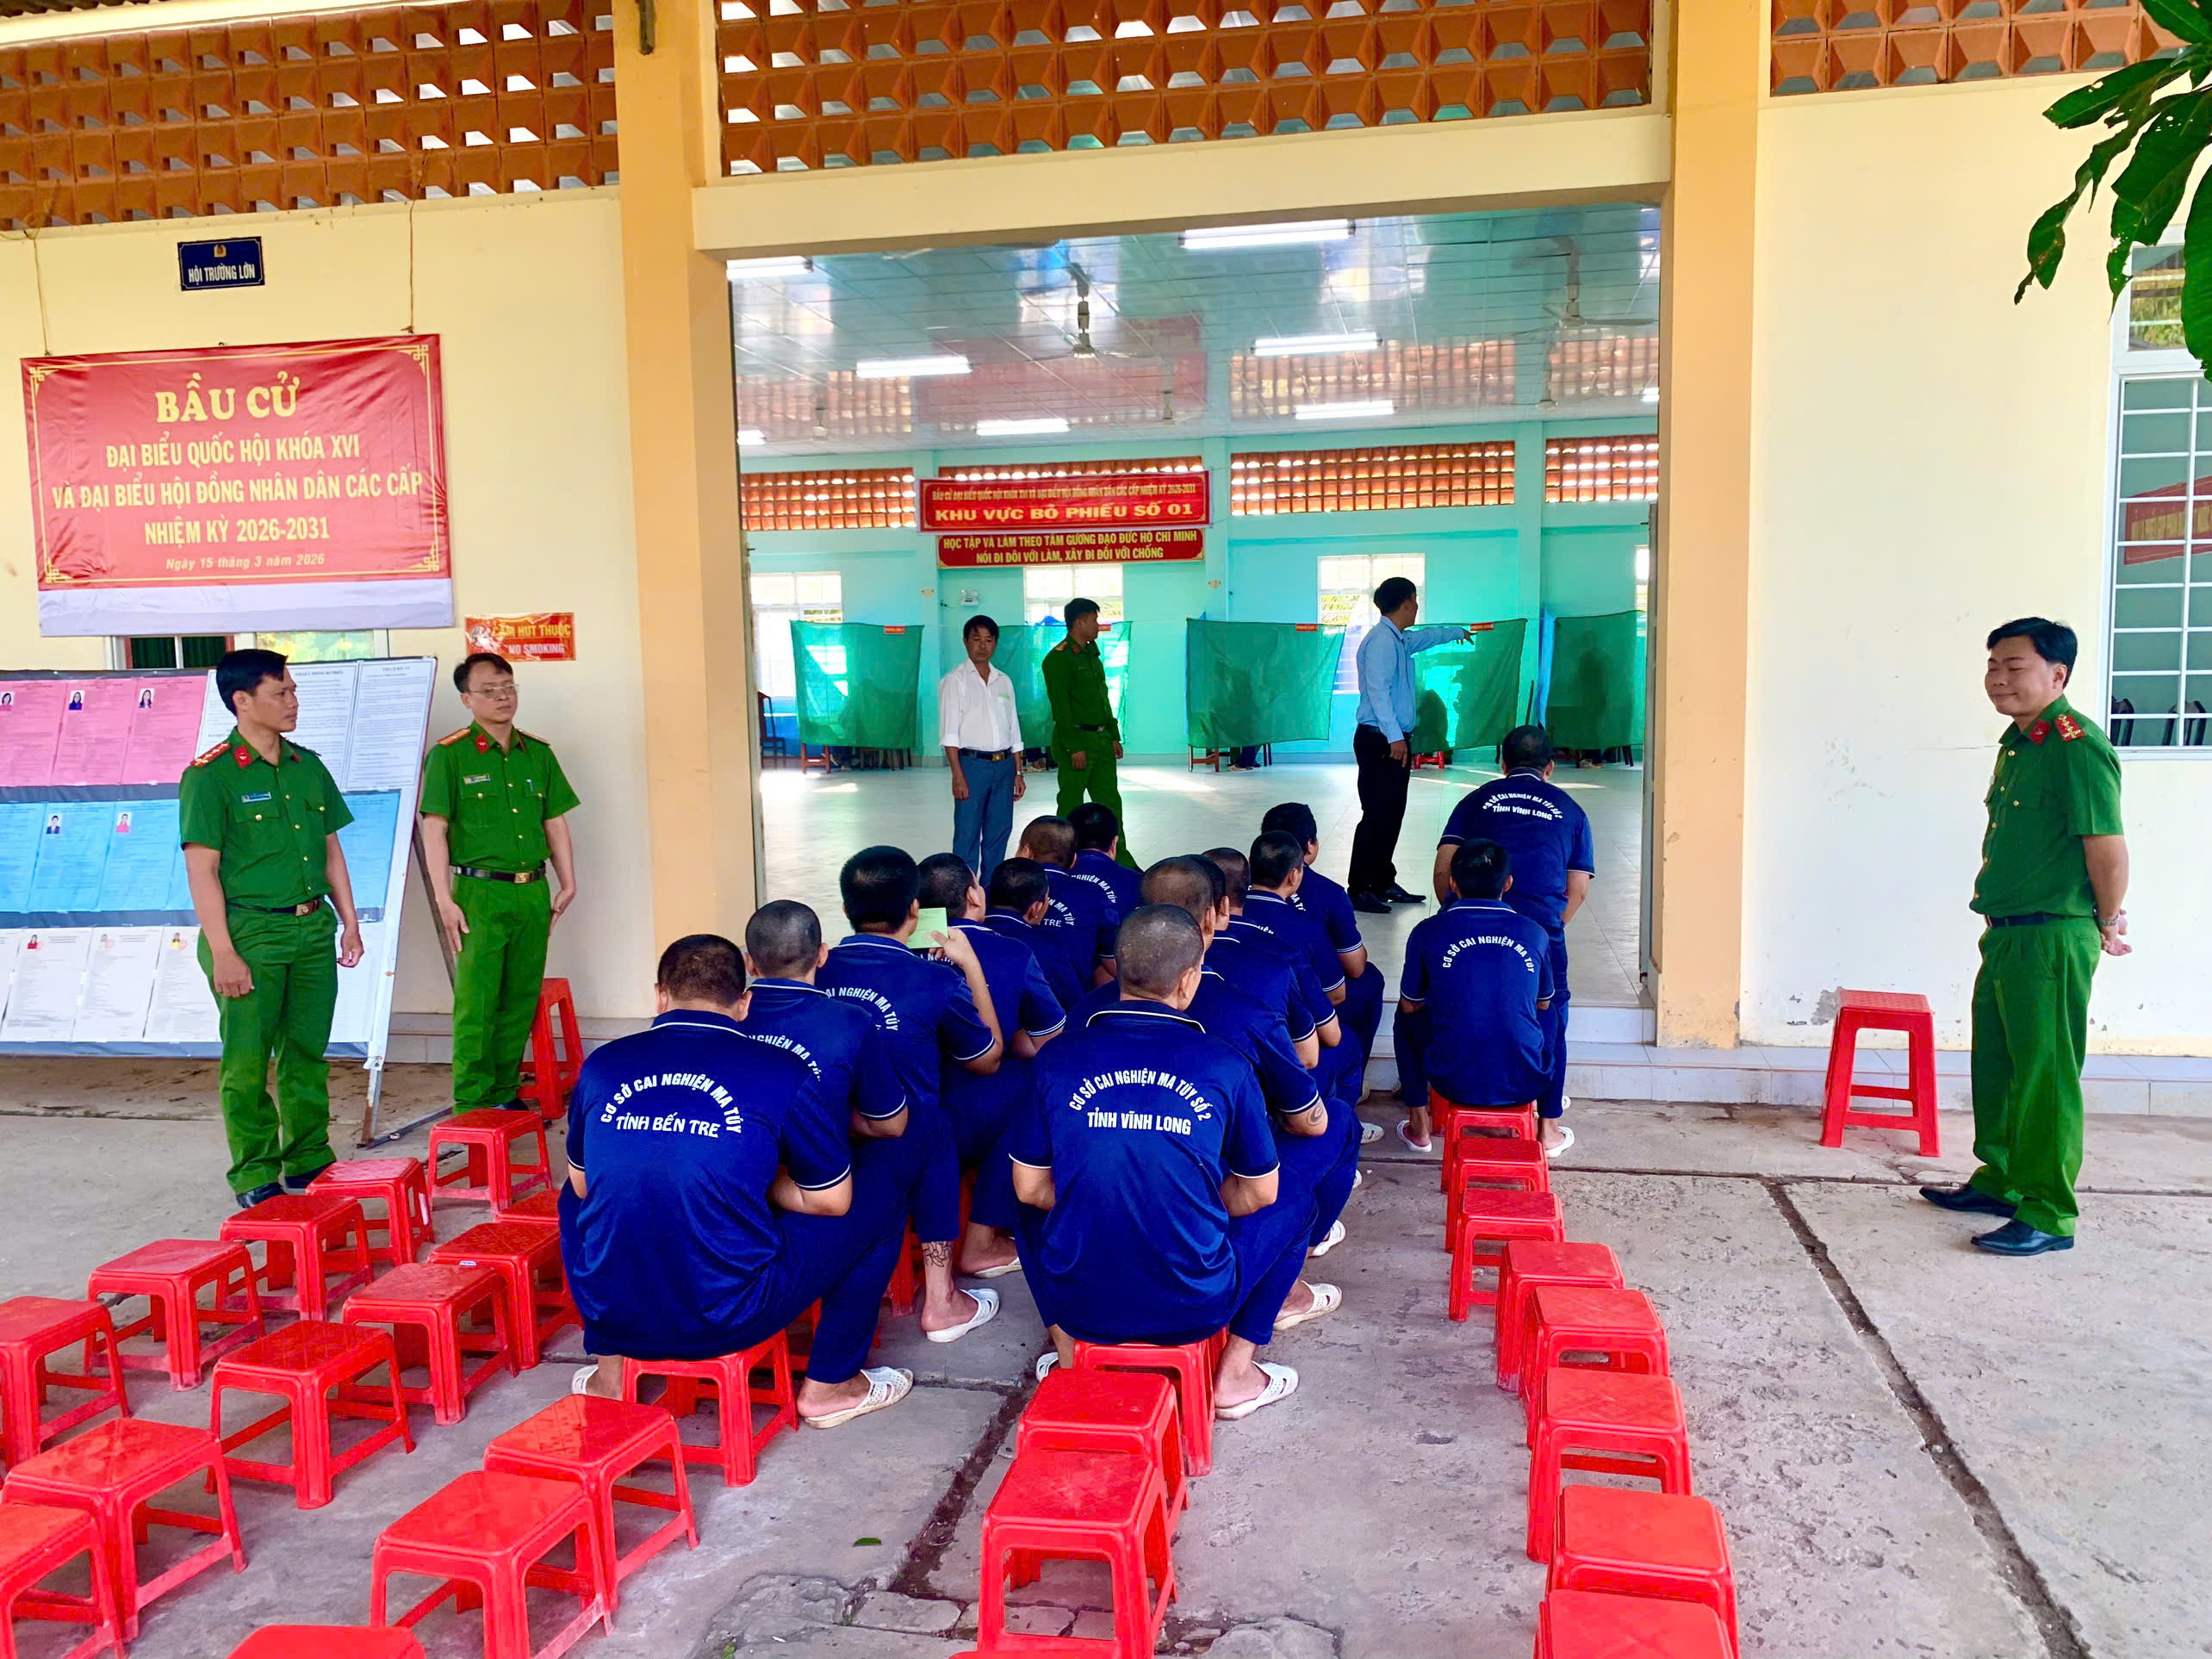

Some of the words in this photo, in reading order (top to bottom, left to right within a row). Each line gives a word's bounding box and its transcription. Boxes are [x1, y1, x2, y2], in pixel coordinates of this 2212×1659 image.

[188, 264, 202, 285] HỘI
[203, 263, 238, 282] TRƯỜNG
[239, 262, 256, 279] LỚN
[155, 372, 235, 423] BẦU
[246, 370, 300, 419] CỬ
[106, 444, 137, 473] ĐẠI
[140, 431, 182, 466] BIỂU
[187, 432, 234, 469] QUỐC
[239, 432, 270, 467] HỘI
[276, 431, 325, 461] KHÓA
[331, 434, 360, 458] XVI
[52, 480, 75, 509] VÀ
[80, 485, 109, 512] ĐẠI
[115, 471, 155, 506] BIỂU
[160, 475, 191, 509] HỘI
[196, 470, 245, 504] ĐỒNG
[248, 472, 298, 502] NHÂN
[303, 469, 340, 500] DÂN
[345, 468, 382, 498] CÁC
[387, 463, 424, 496] CẤP
[935, 510, 977, 520] KHU
[983, 507, 1024, 522] VỰC
[1030, 504, 1059, 519] BỎ
[1066, 502, 1127, 518] PHIẾU
[1134, 500, 1163, 516] SỐ
[1167, 503, 1193, 515] 01
[145, 516, 201, 549] NHIỆM
[206, 513, 229, 544] KỲ
[236, 517, 330, 543] 2026-2031
[943, 538, 961, 551] HỌC
[963, 536, 981, 550] TẬP
[1019, 536, 1042, 547] THEO
[1097, 533, 1116, 546] ĐẠO
[1173, 530, 1197, 542] MINH
[165, 558, 196, 571] Ngày
[200, 557, 214, 569] 15
[218, 556, 250, 569] tháng
[255, 556, 262, 567] 3
[266, 555, 291, 566] năm
[296, 553, 325, 565] 2026
[976, 550, 991, 563] NÓI
[993, 552, 1003, 563] ĐI
[1005, 550, 1021, 562] ĐÔI
[1023, 549, 1038, 562] VỚI
[1041, 549, 1063, 562] LÀM,
[1065, 548, 1083, 560] XÂY
[1084, 550, 1095, 560] ĐI
[1115, 546, 1130, 559] VỚI
[1133, 544, 1164, 558] CHỐNG
[508, 644, 521, 655] NO
[523, 643, 565, 655] SMOKING
[1492, 803, 1510, 812] TỈNH
[1512, 805, 1531, 815] VĨNH
[1532, 810, 1552, 820] LONG
[1097, 880, 1111, 891] MA
[1043, 918, 1062, 927] TRE
[1054, 901, 1068, 913] MA
[1063, 912, 1075, 926] TÚY
[1442, 956, 1452, 968] CƠ
[1447, 943, 1461, 957] SỞ
[1458, 937, 1476, 948] CAI
[1477, 935, 1514, 948] NGHIỆN
[1513, 943, 1528, 957] MA
[838, 986, 879, 1002] NGHIỆN
[874, 996, 892, 1013] MA
[884, 1010, 900, 1031] TÚY
[791, 1044, 811, 1060] MA
[1094, 1072, 1114, 1090] CAI
[1114, 1068, 1156, 1087] NGHIỆN
[1157, 1072, 1177, 1090] MA
[1078, 1078, 1097, 1099] SỞ
[1175, 1078, 1197, 1101] TÚY
[600, 1103, 617, 1122] CƠ
[613, 1083, 633, 1105] SỞ
[633, 1075, 657, 1091] CAI
[661, 1072, 715, 1092] NGHIỆN
[709, 1085, 733, 1109] MA
[724, 1107, 743, 1134] TÚY
[1069, 1092, 1085, 1111] CƠ
[1190, 1096, 1213, 1113] SỐ
[616, 1112, 649, 1130] TỈNH
[652, 1112, 686, 1132] BẾN
[689, 1120, 721, 1138] TRE
[1087, 1107, 1117, 1128] TỈNH
[1121, 1110, 1153, 1130] VĨNH
[1155, 1115, 1191, 1135] LONG
[1197, 1112, 1212, 1122] 2
